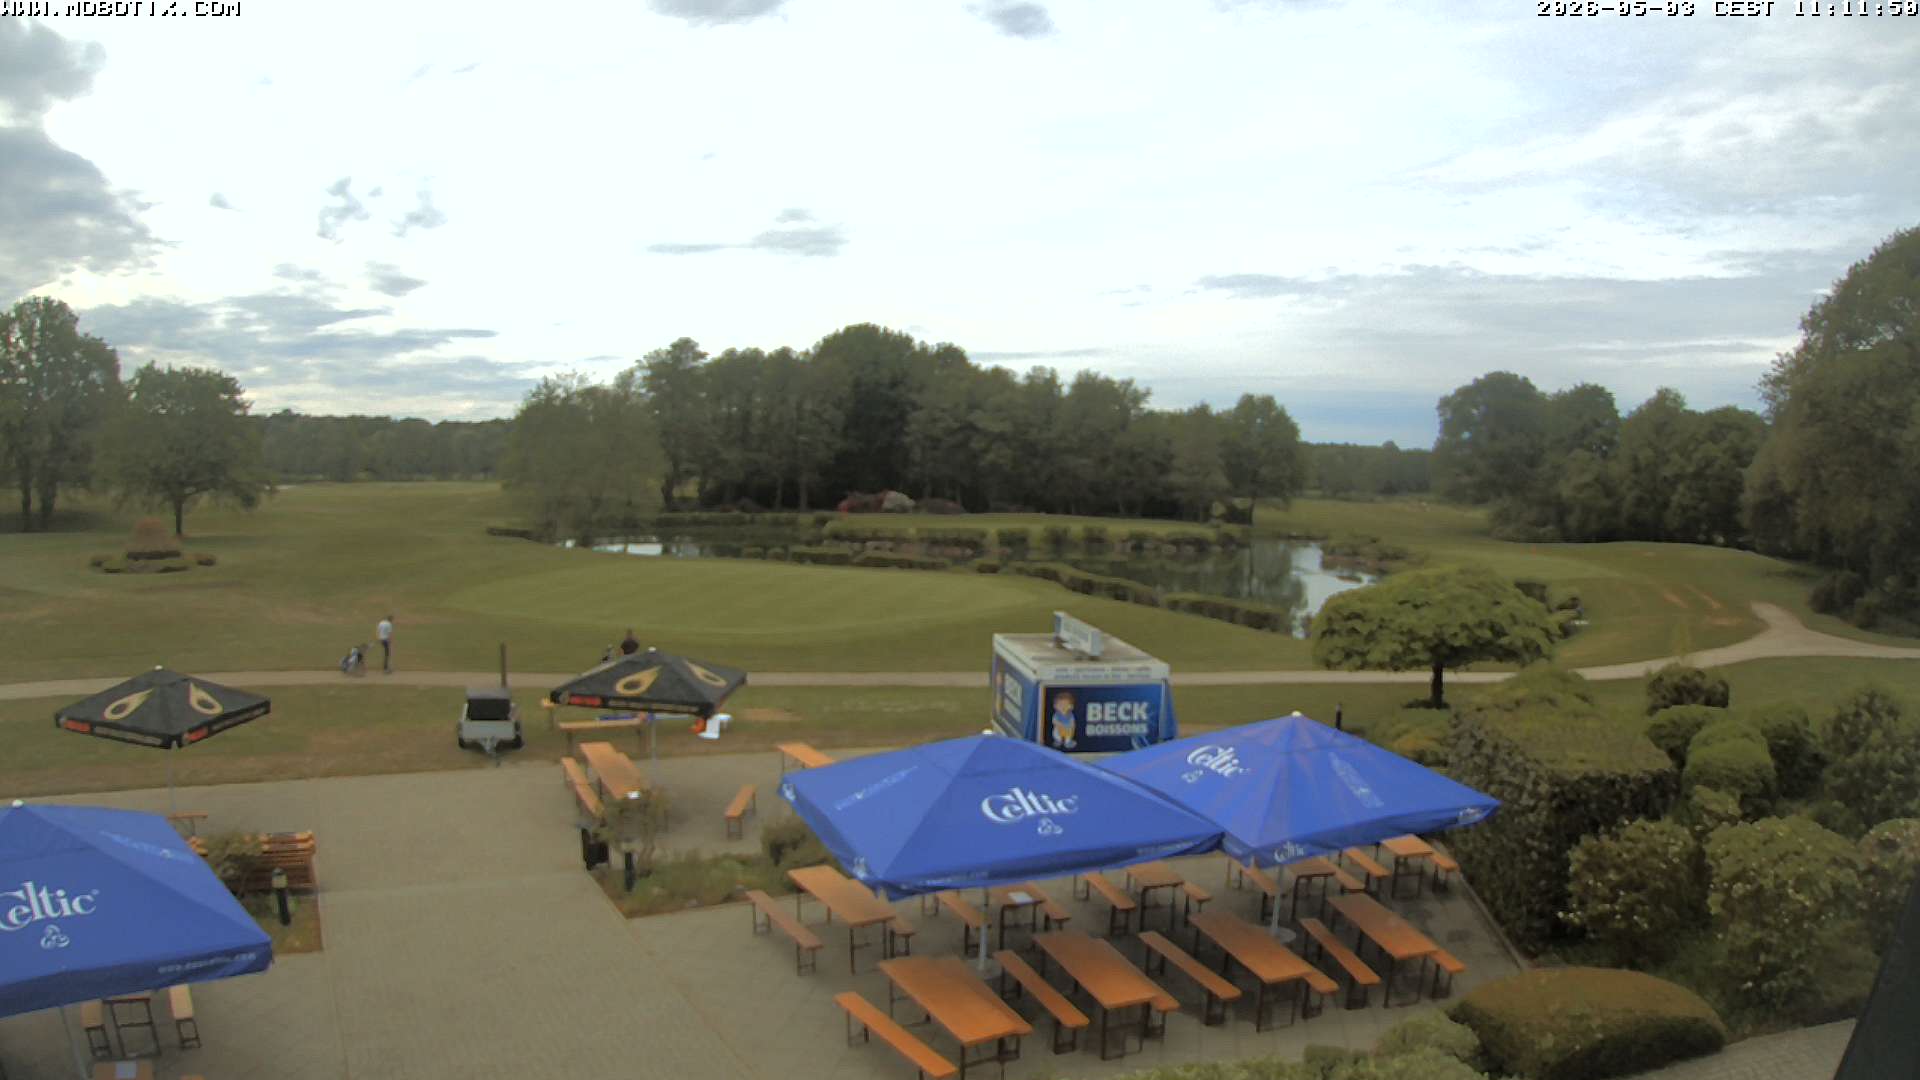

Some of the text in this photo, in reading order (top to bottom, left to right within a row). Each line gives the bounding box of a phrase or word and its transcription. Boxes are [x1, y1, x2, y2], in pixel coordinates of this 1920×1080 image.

[1086, 702, 1149, 722] BECK
[1085, 723, 1149, 737] BOISSONS
[1187, 745, 1244, 777] Celtic
[981, 787, 1078, 822] Celtic
